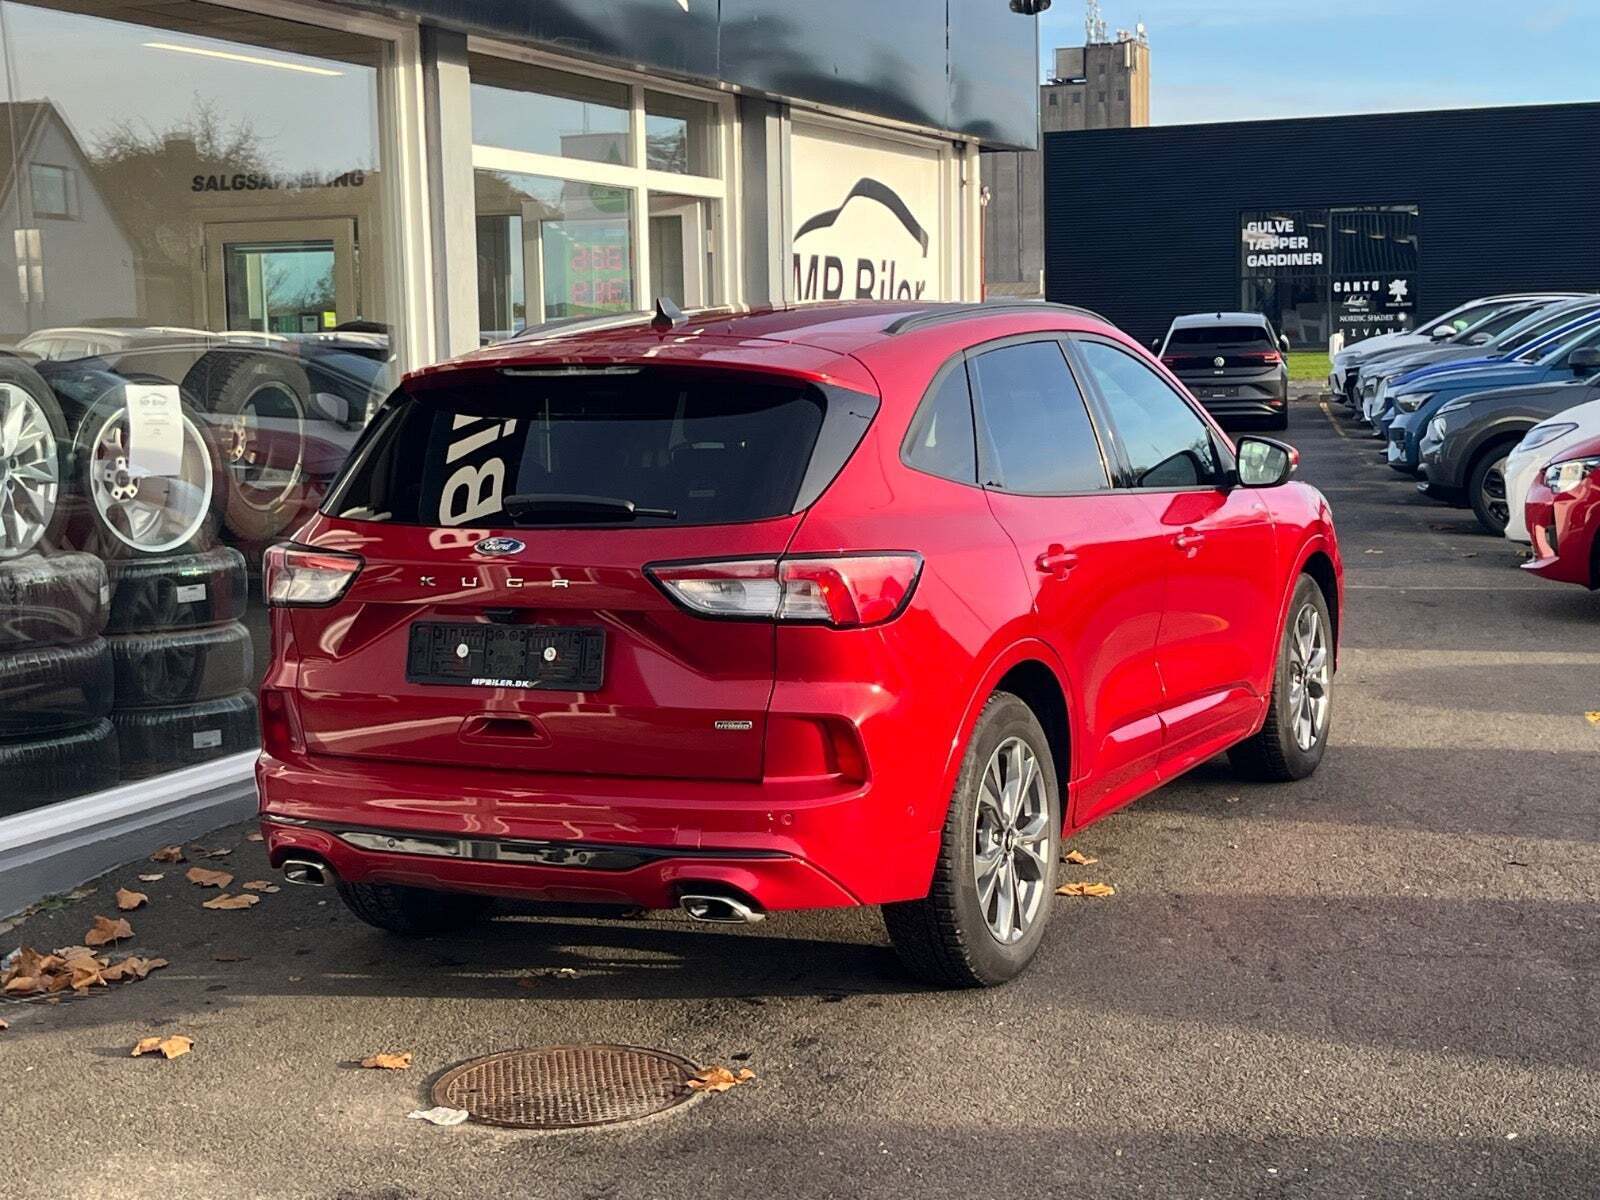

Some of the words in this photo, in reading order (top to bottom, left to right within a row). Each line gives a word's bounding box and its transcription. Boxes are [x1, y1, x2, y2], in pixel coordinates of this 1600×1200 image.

[1247, 220, 1294, 233] GULVE
[1248, 236, 1309, 250] TÆPPER
[1247, 253, 1323, 267] GARDINER
[1333, 281, 1380, 292] CANTO
[419, 575, 569, 588] KUGA
[471, 678, 529, 688] MPBILER.DK
